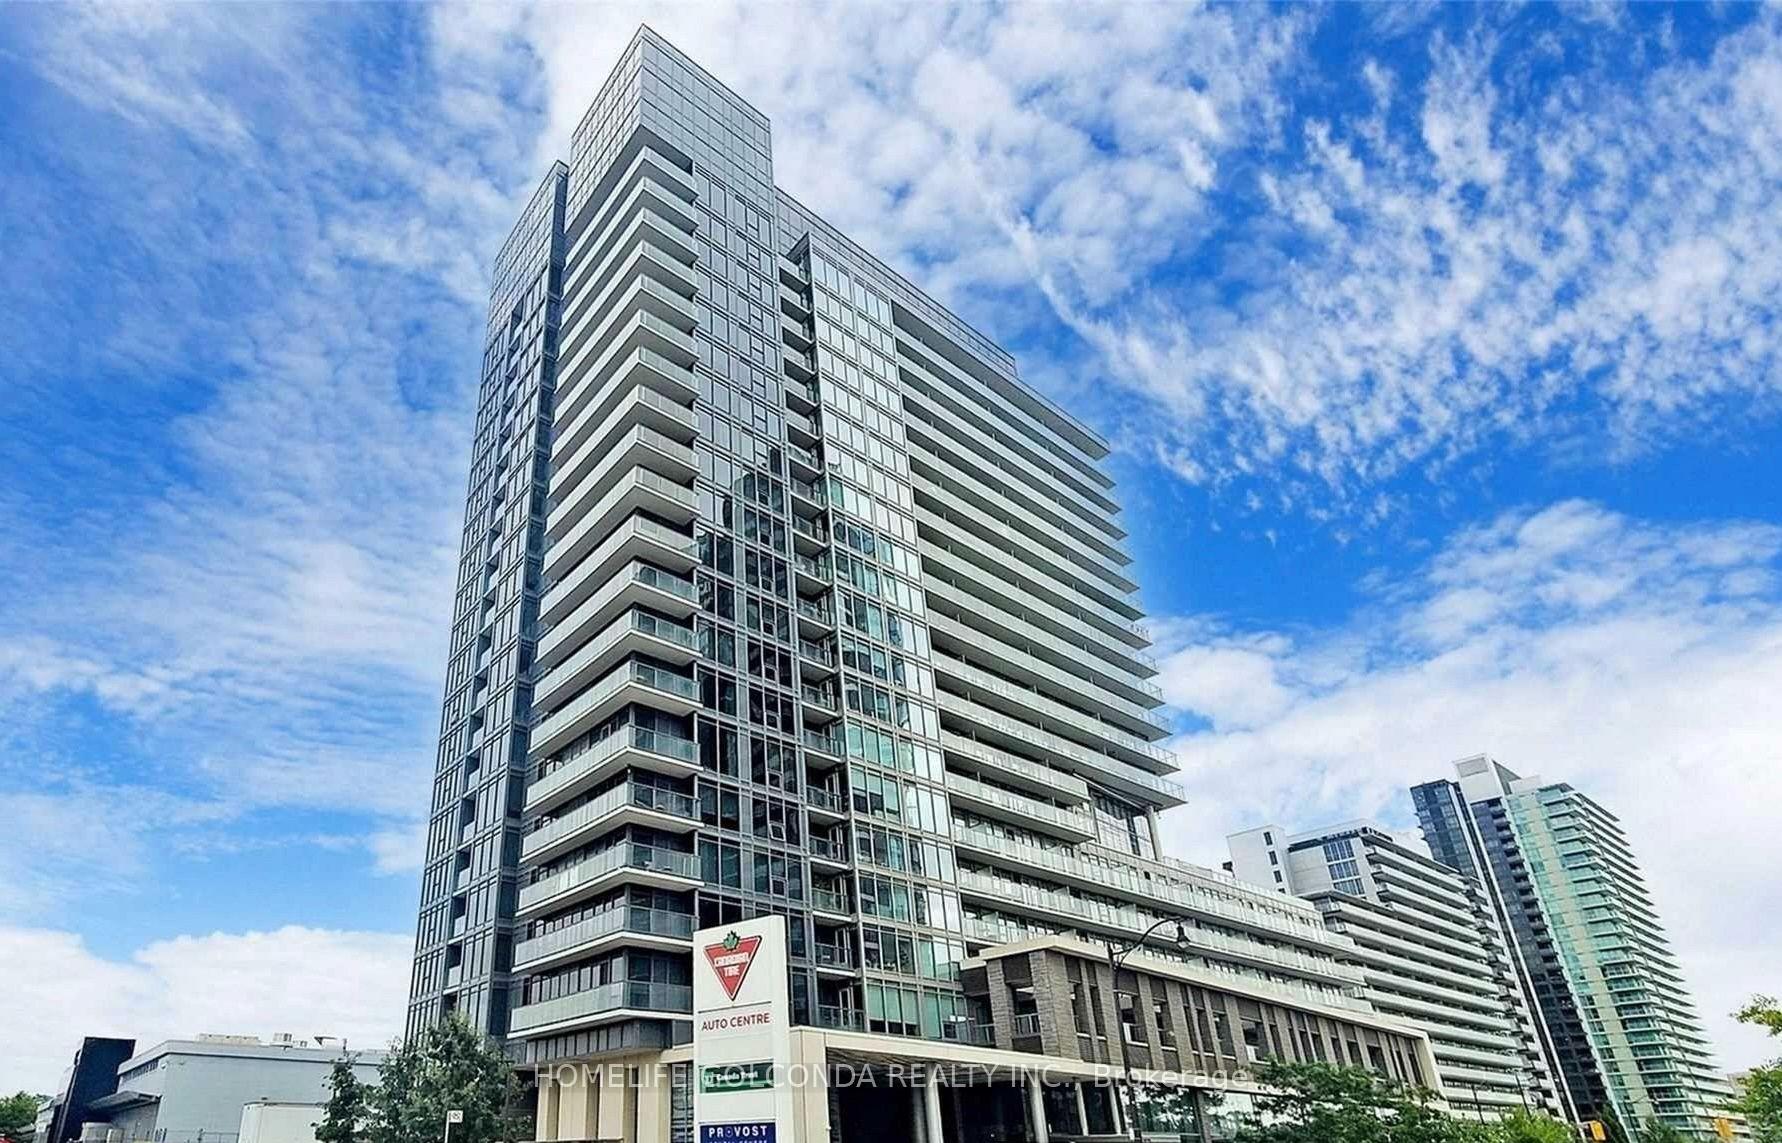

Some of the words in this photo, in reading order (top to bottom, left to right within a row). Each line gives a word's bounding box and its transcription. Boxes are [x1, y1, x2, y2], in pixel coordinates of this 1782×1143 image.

[702, 1018, 728, 1031] AUTO
[730, 1012, 770, 1028] CENTRE
[708, 1125, 767, 1138] PROVOST
